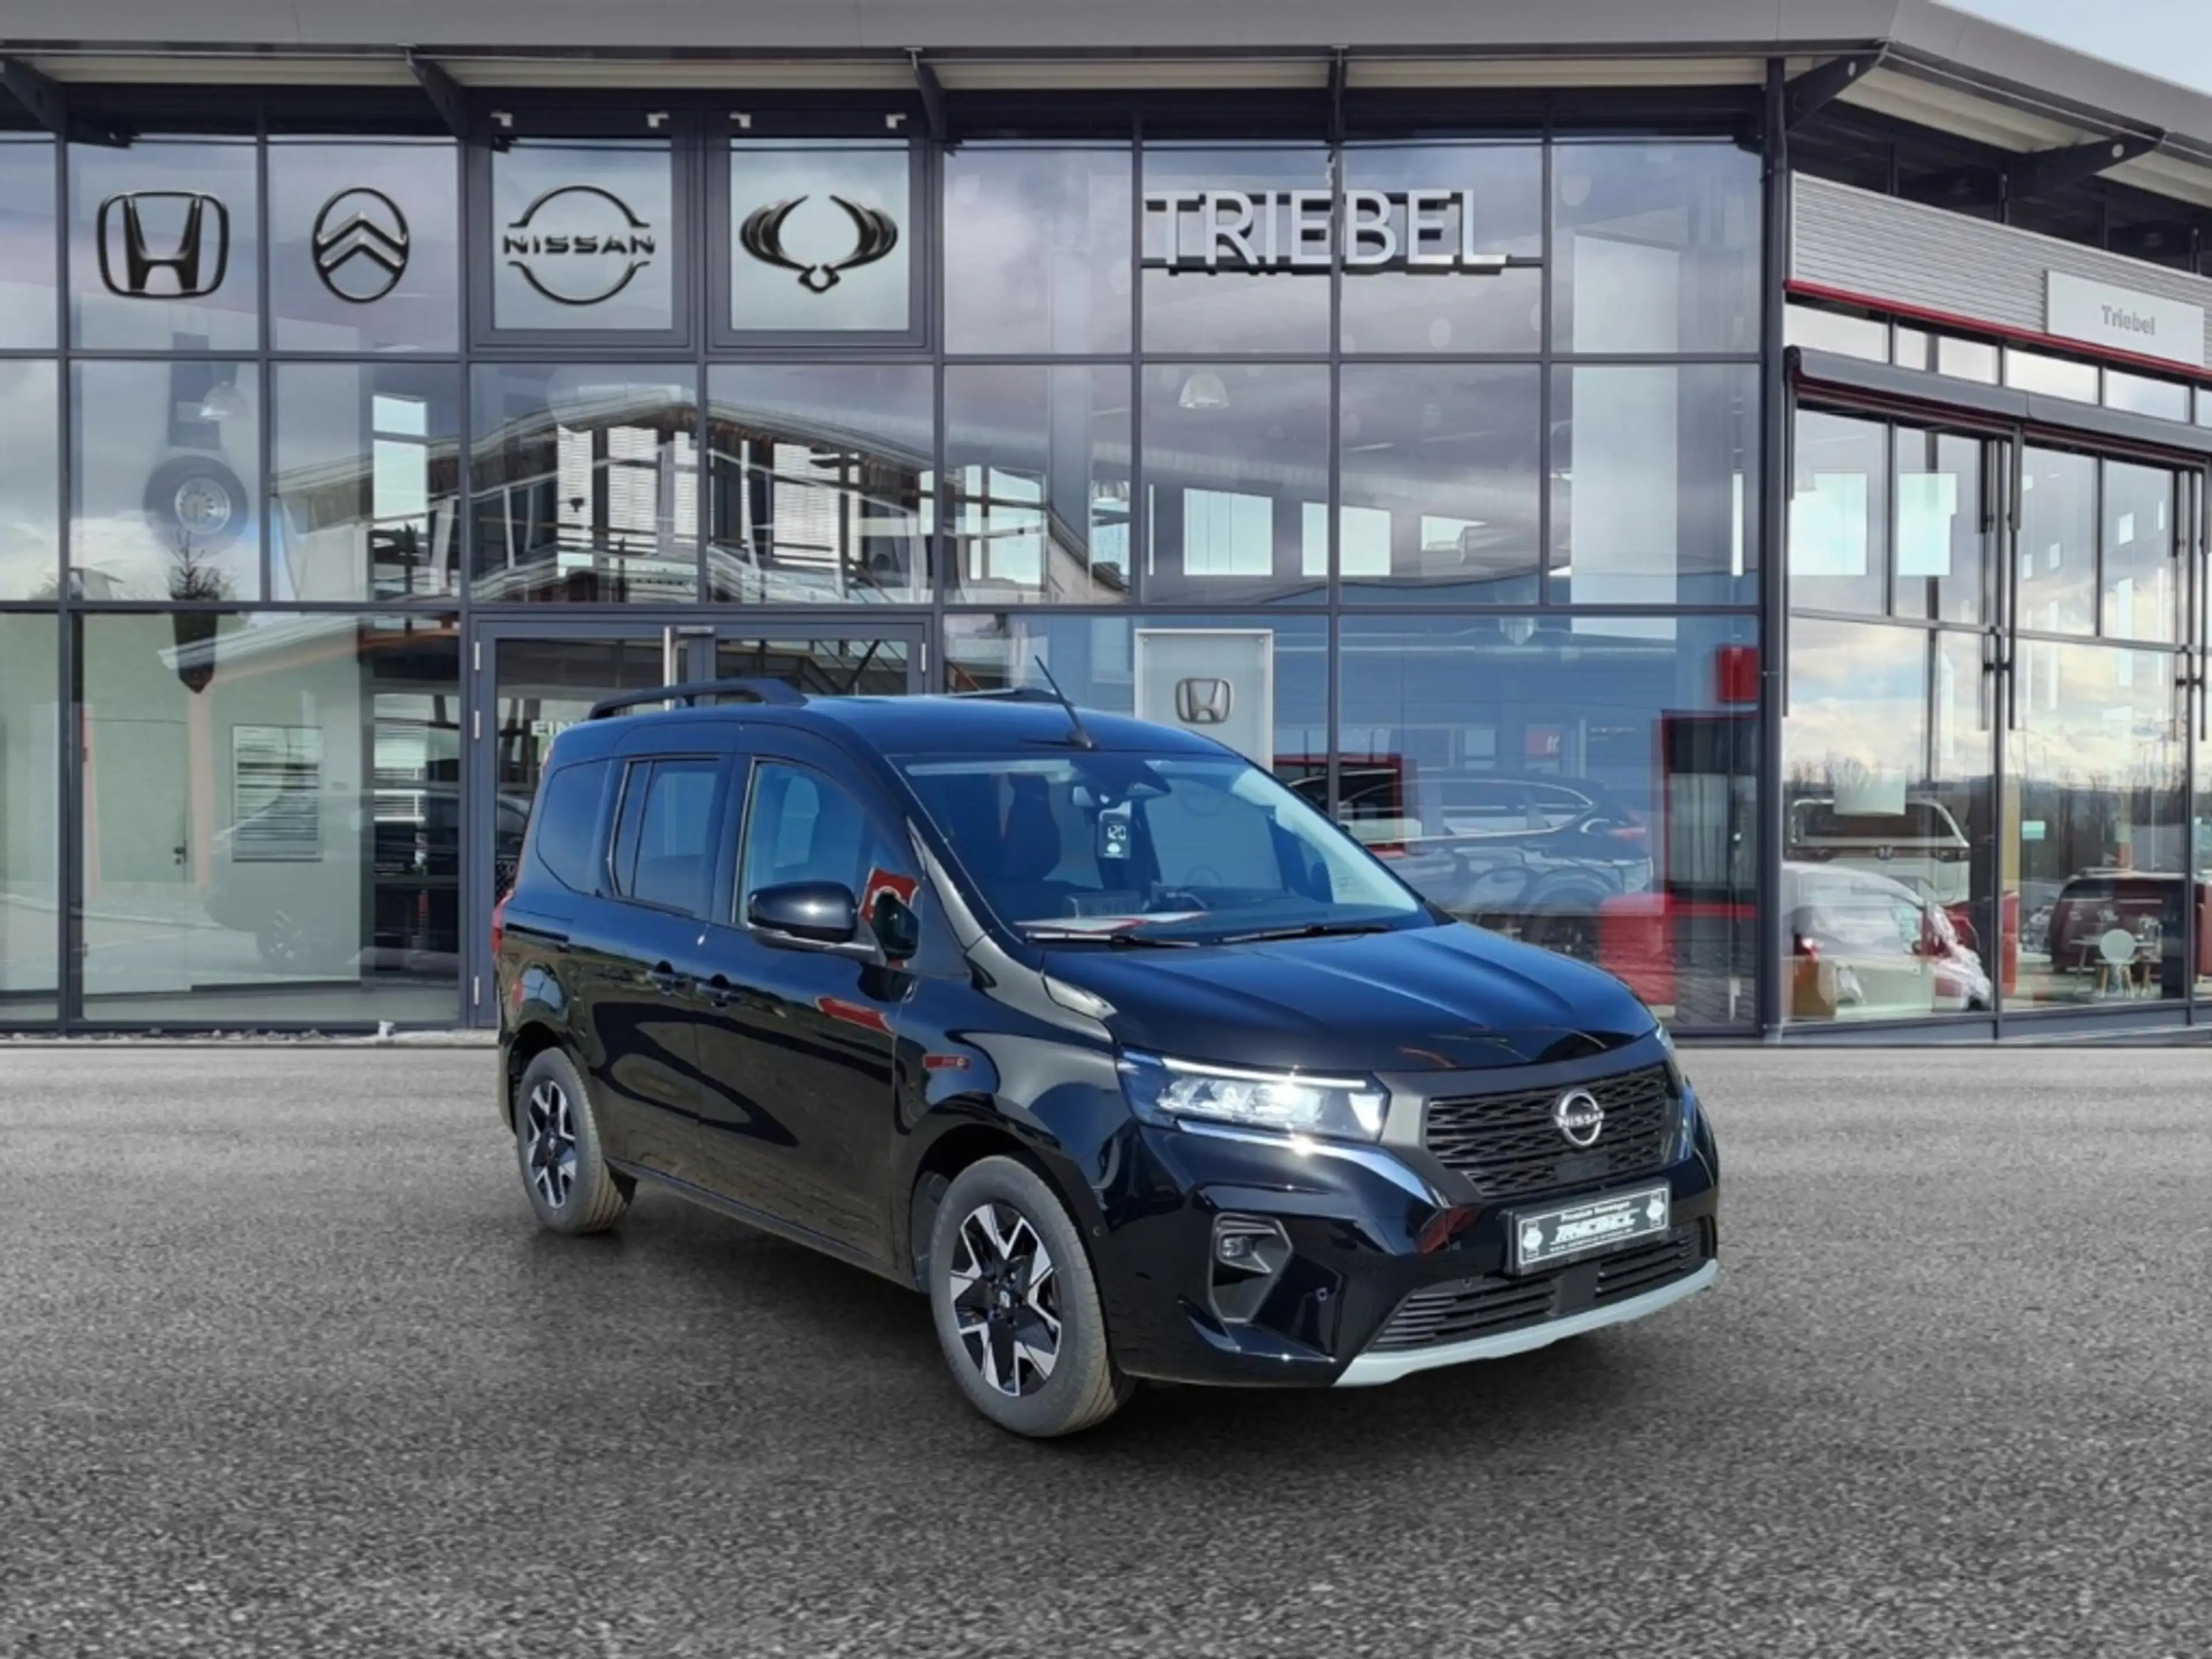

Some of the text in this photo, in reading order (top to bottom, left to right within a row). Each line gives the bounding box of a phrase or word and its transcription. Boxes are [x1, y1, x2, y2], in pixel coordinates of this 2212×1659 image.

[1144, 189, 1507, 266] TRIEBEL
[503, 235, 655, 255] NISSAN
[2101, 304, 2156, 336] Triebel
